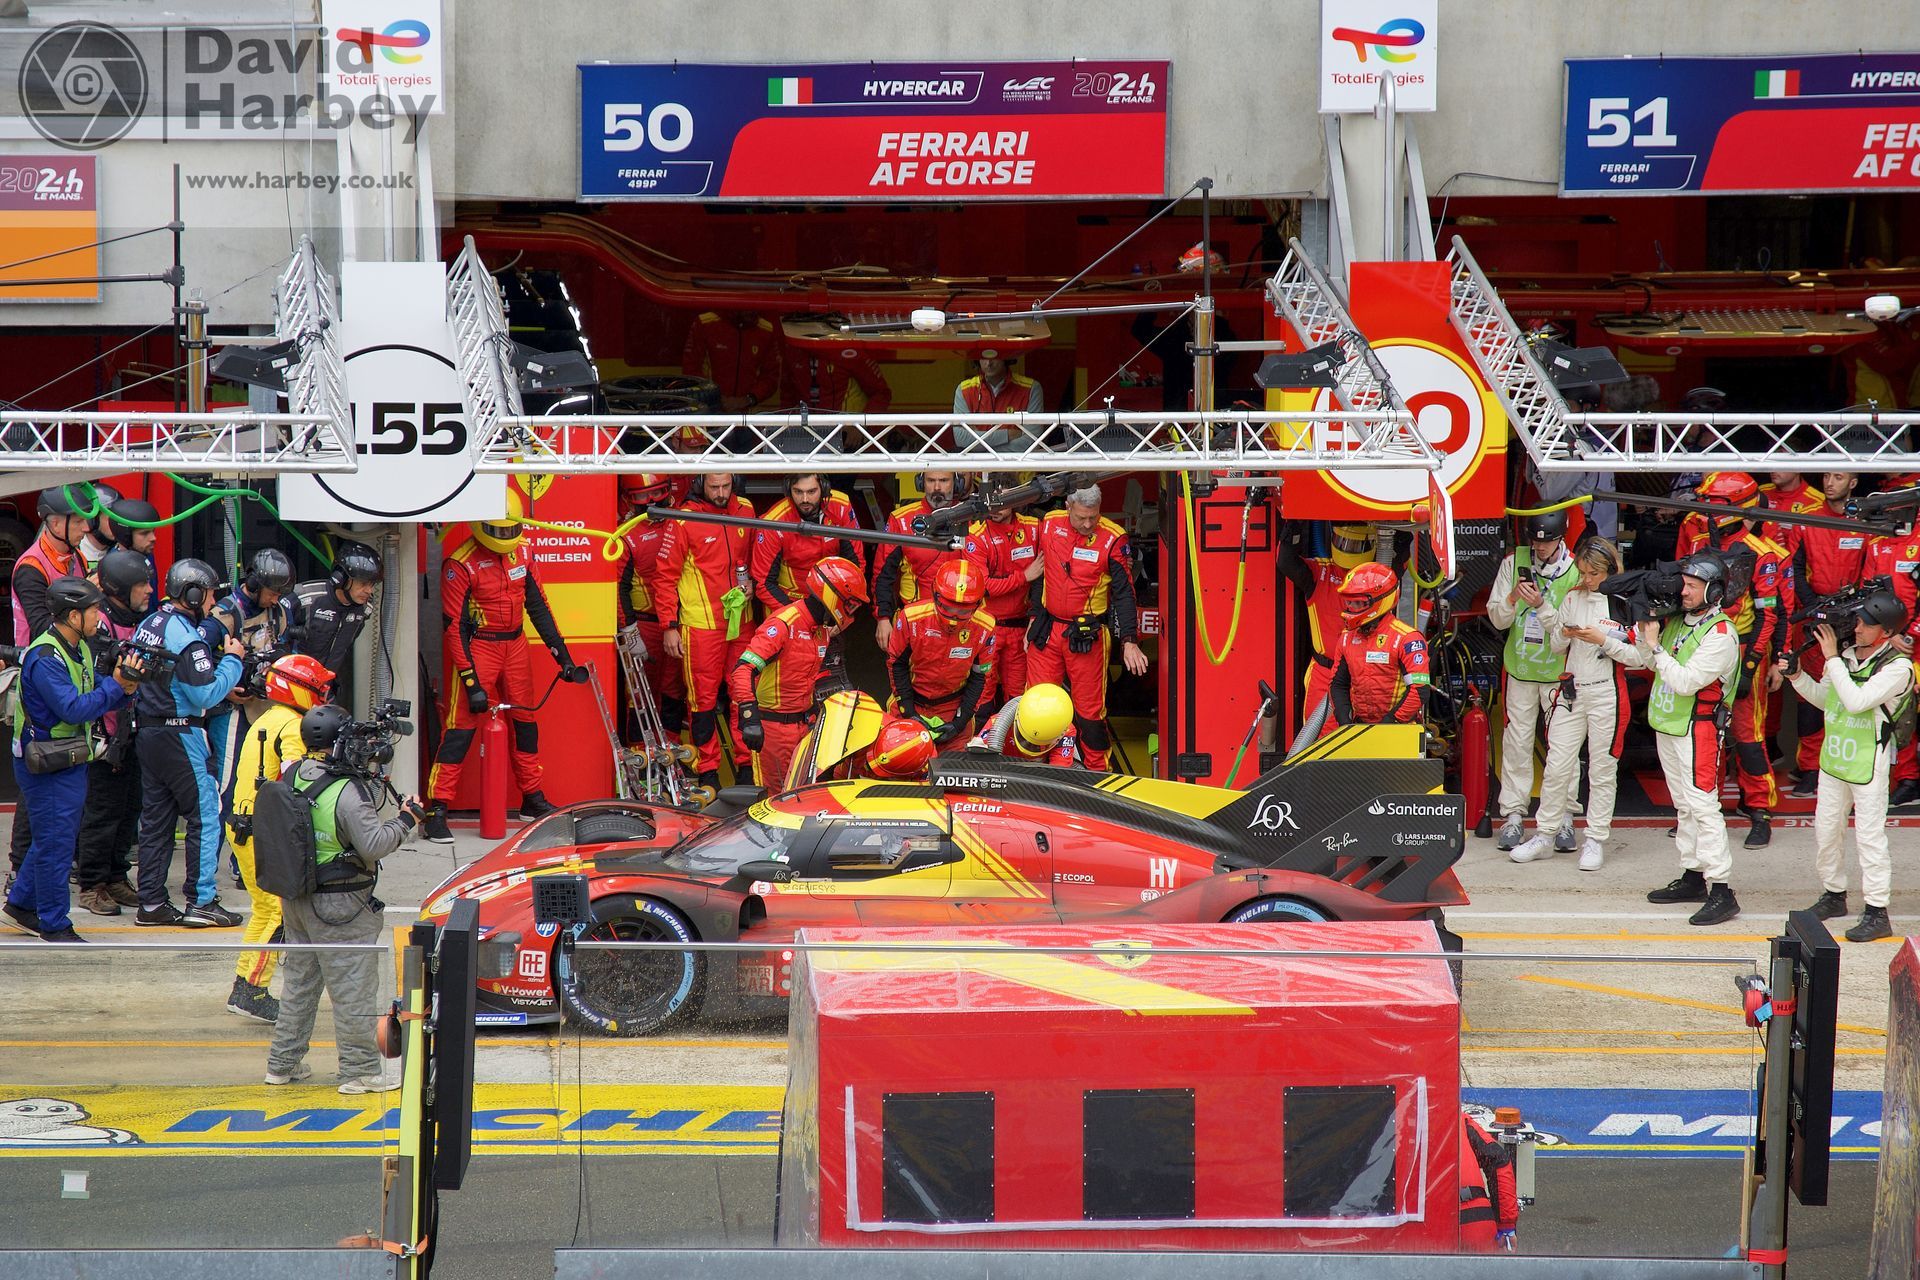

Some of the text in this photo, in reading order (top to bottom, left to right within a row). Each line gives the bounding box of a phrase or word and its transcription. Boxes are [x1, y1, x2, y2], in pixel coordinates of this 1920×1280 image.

[1331, 72, 1425, 87] TotalEnrgies
[863, 80, 966, 96] HYPERCAR
[1106, 95, 1152, 104] LE MANS
[603, 102, 694, 153] 50
[1587, 97, 1678, 148] 51
[877, 130, 1030, 158] FERRARI
[1600, 163, 1650, 173] FERRARI
[1853, 154, 1905, 178] AF
[618, 168, 668, 178] FERRARI
[868, 160, 1036, 187] AF CORSE
[1609, 174, 1640, 183] 499P
[627, 179, 658, 188] 499P
[34, 192, 81, 201] LE MANS
[1453, 523, 1501, 535] ntander
[536, 537, 591, 547] MOLINA
[534, 553, 592, 563] NIELSEN
[935, 776, 978, 788] ADLER
[1387, 802, 1458, 817] Santander
[1062, 873, 1095, 882] ECOPOL
[1150, 857, 1178, 888] HY
[791, 883, 836, 894] GENESYS
[1235, 903, 1270, 923] CHELIN
[501, 984, 549, 997] V-Power
